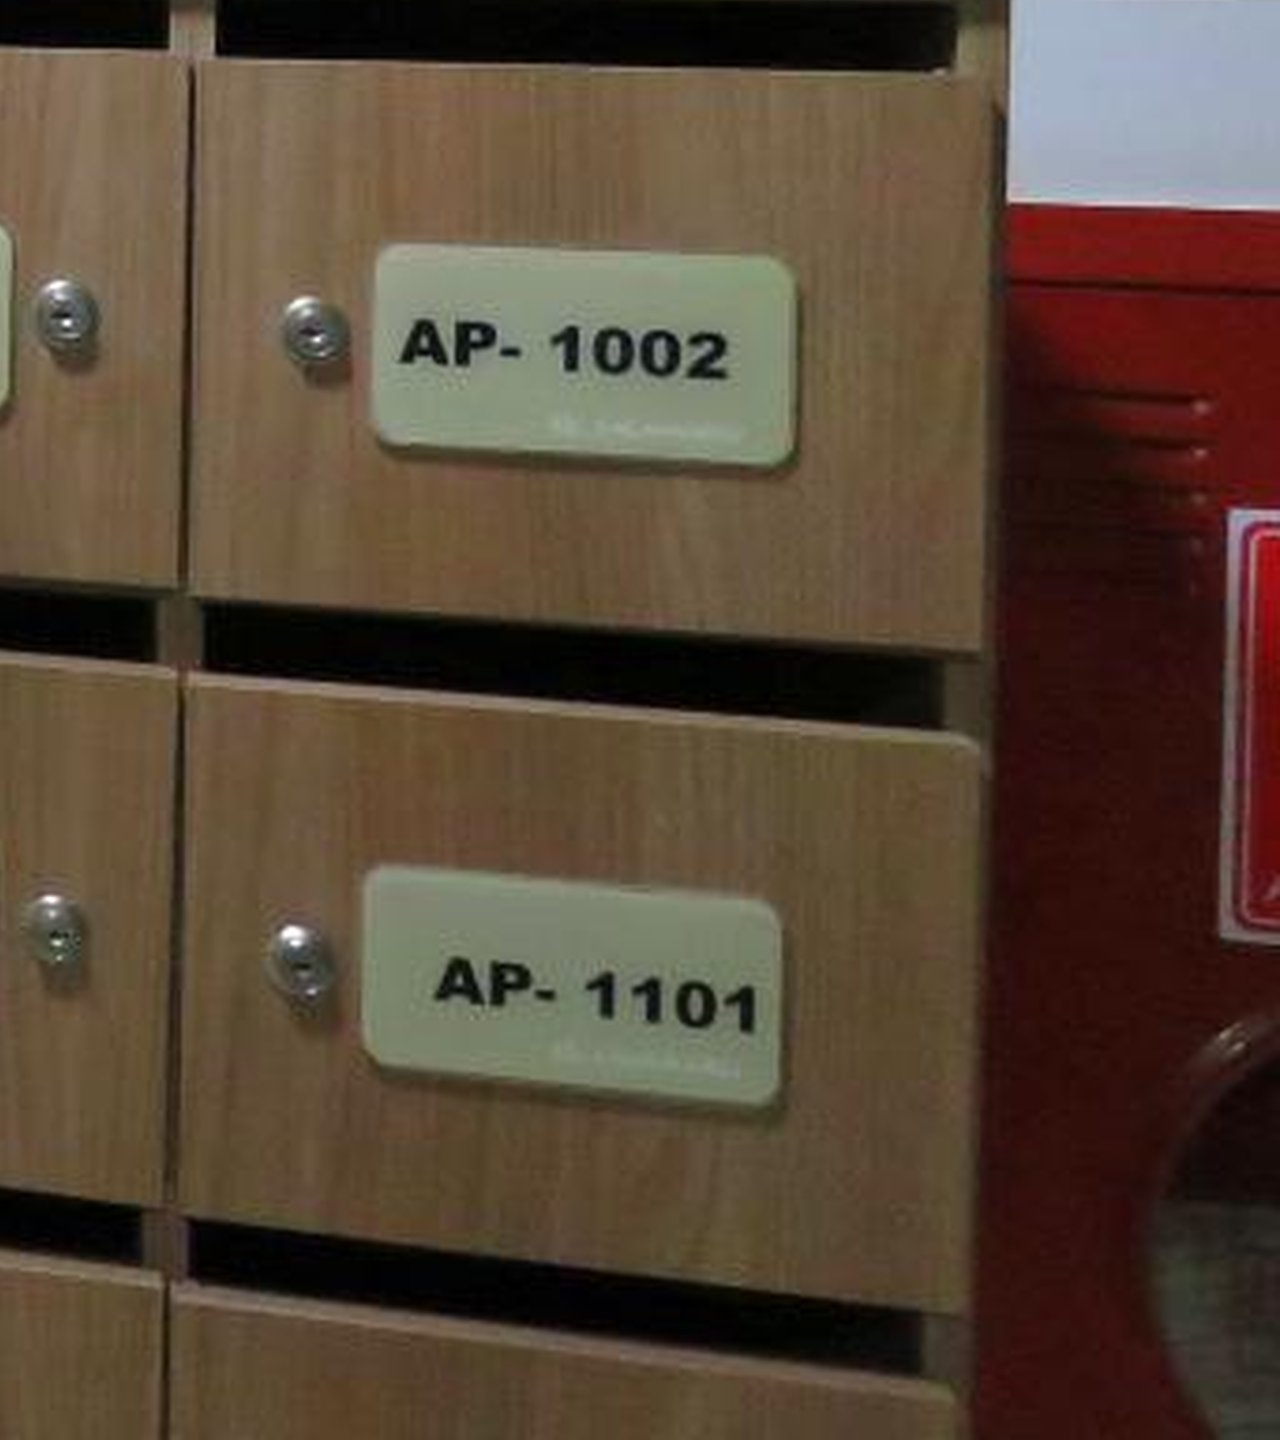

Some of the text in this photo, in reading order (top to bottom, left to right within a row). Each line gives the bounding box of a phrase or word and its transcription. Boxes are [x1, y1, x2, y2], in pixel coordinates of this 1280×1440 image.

[399, 318, 729, 380] AP- 1002
[434, 956, 755, 1033] AP- 1101
